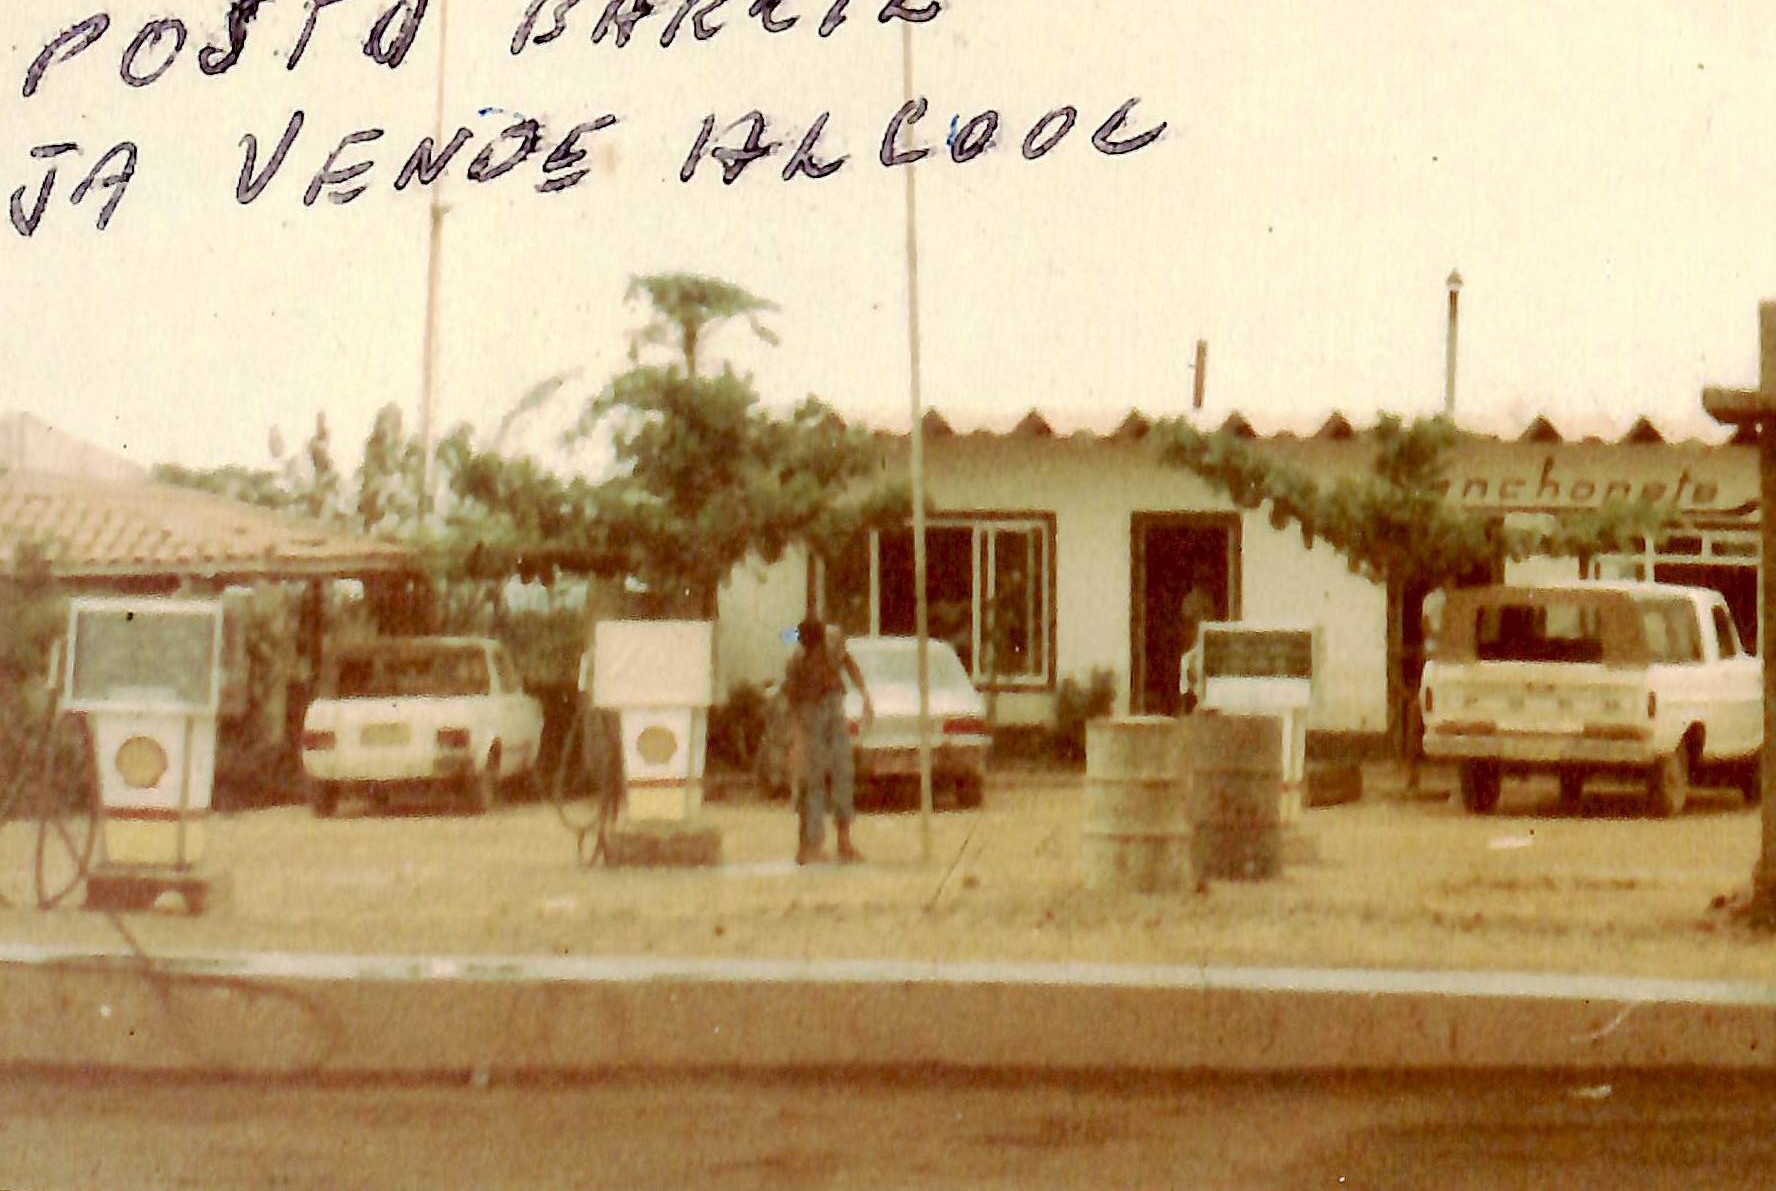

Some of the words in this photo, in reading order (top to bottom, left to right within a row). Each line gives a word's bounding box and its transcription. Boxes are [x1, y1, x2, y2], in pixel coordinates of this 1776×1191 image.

[9, 141, 138, 237] JA
[234, 109, 619, 205] VENDE
[678, 96, 1169, 186] ALCOOL
